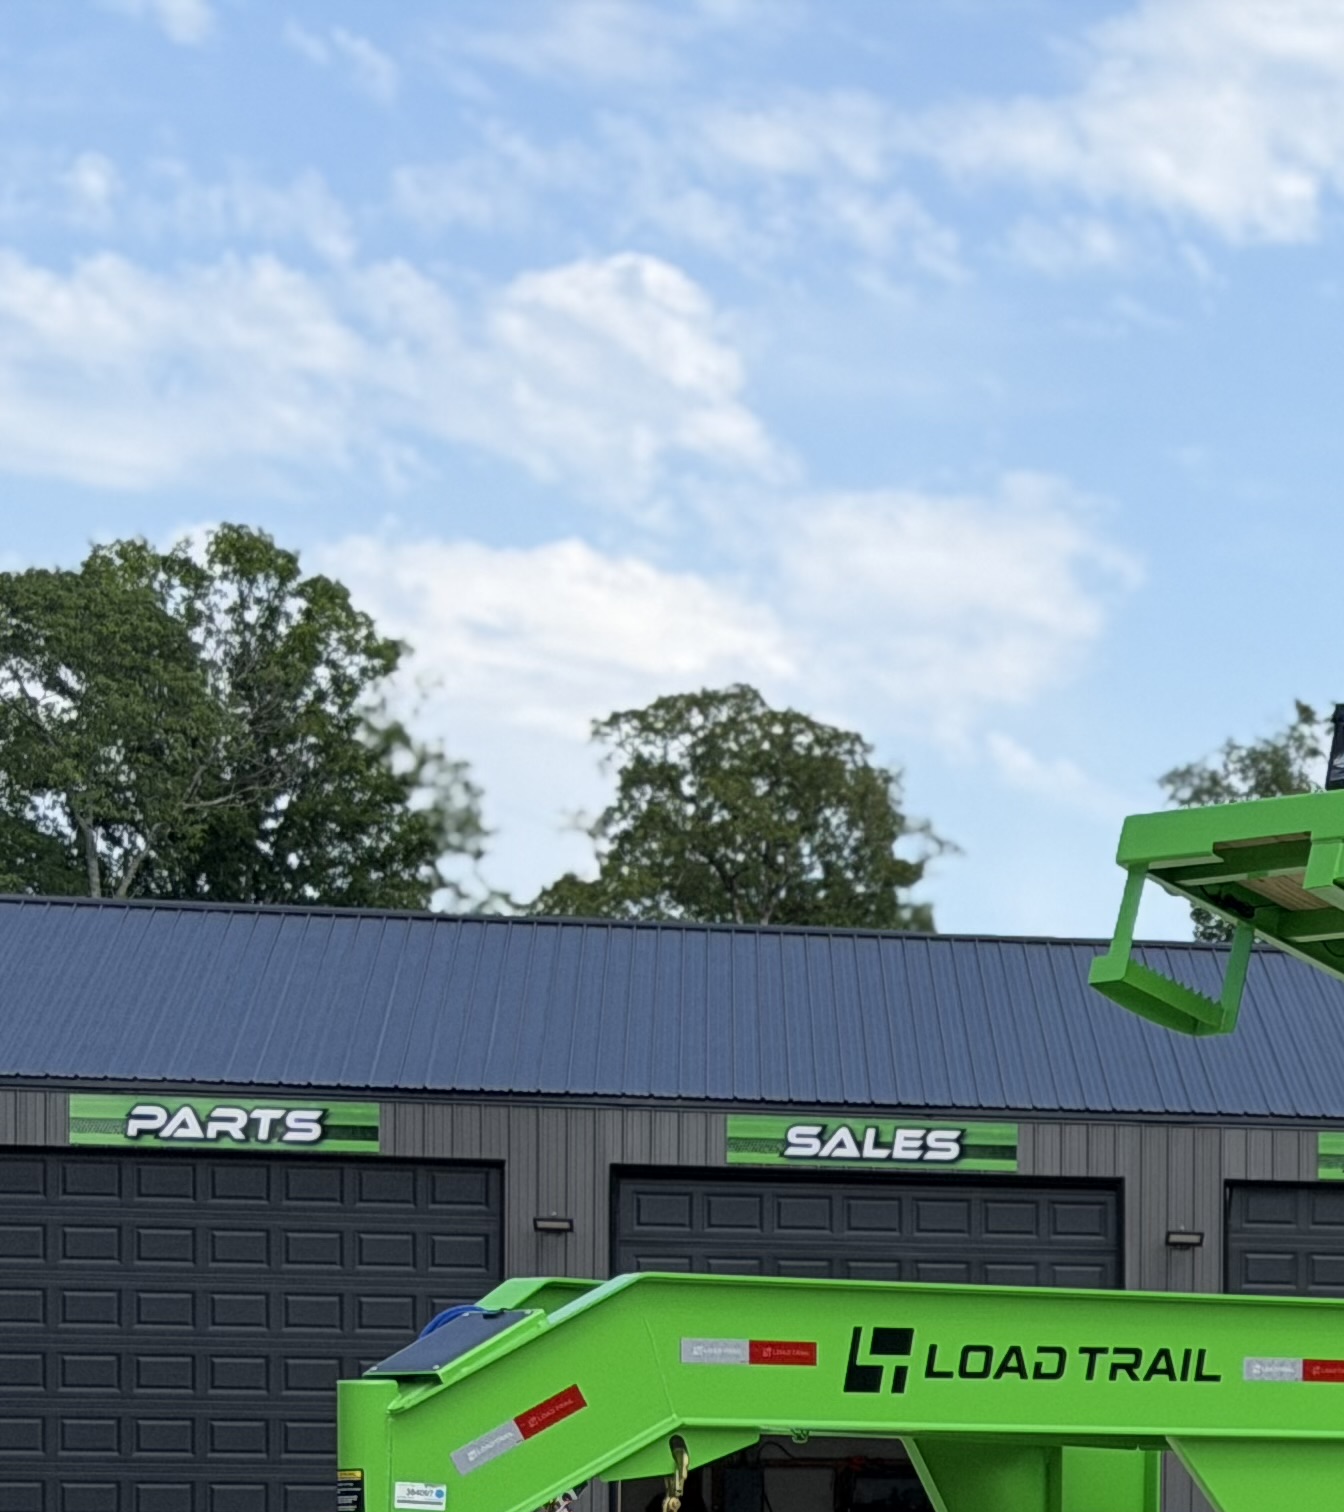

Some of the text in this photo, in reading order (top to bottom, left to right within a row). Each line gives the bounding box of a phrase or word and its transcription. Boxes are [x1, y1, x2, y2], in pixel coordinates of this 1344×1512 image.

[126, 1104, 324, 1142] PARTS
[783, 1125, 963, 1161] SALES
[924, 1343, 1222, 1382] LOAD TRAIL
